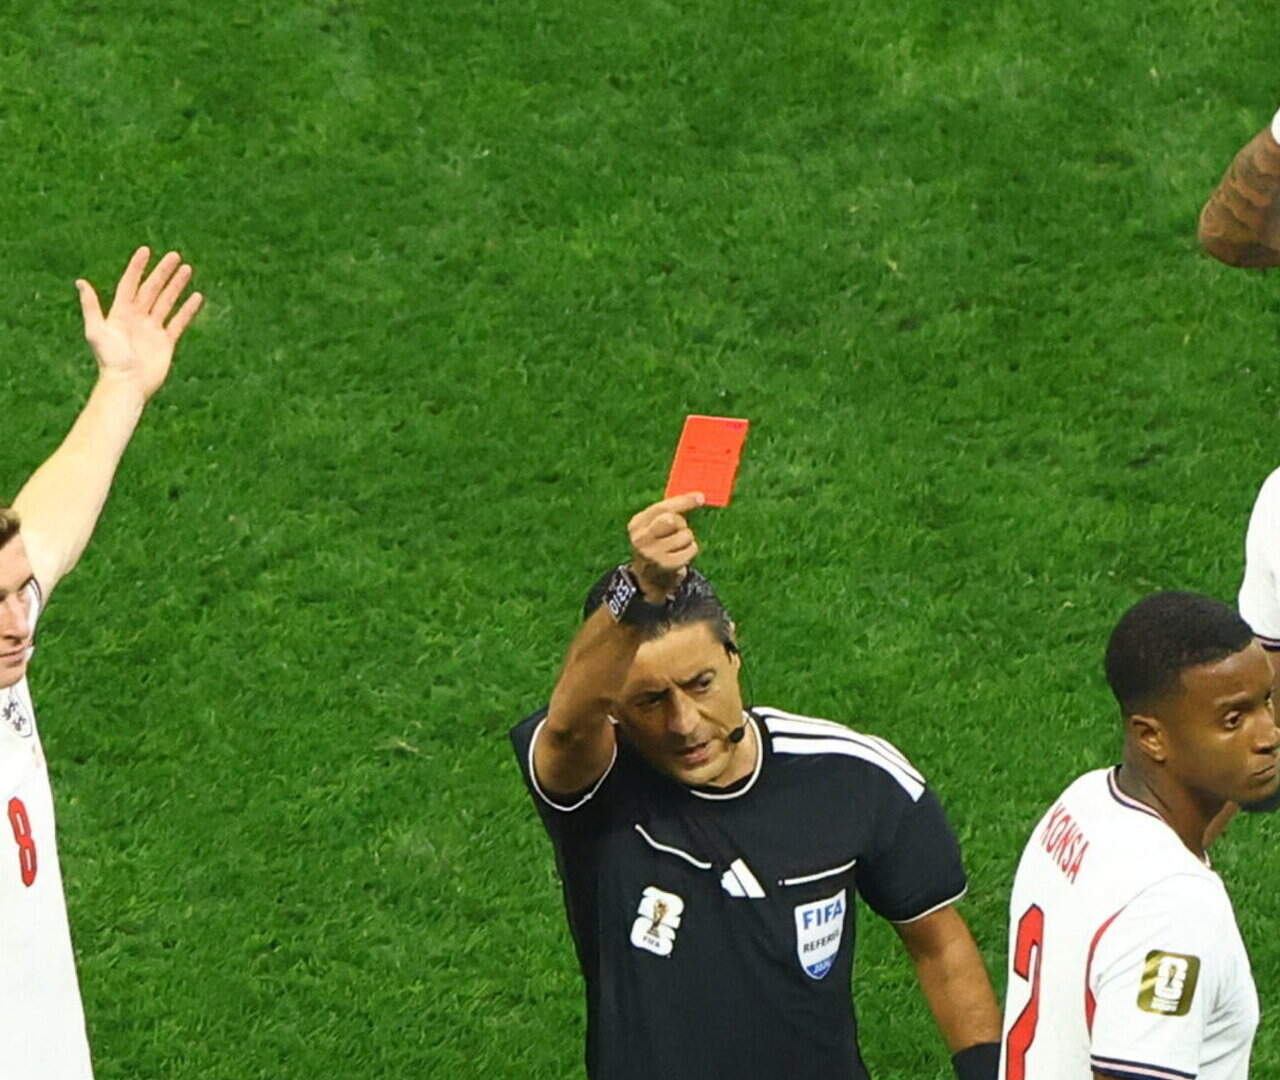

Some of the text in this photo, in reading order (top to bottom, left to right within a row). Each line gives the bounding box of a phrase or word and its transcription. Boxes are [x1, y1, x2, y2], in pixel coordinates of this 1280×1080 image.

[7, 796, 38, 888] 8
[1041, 801, 1090, 885] KONSA
[802, 899, 843, 931] FIFA
